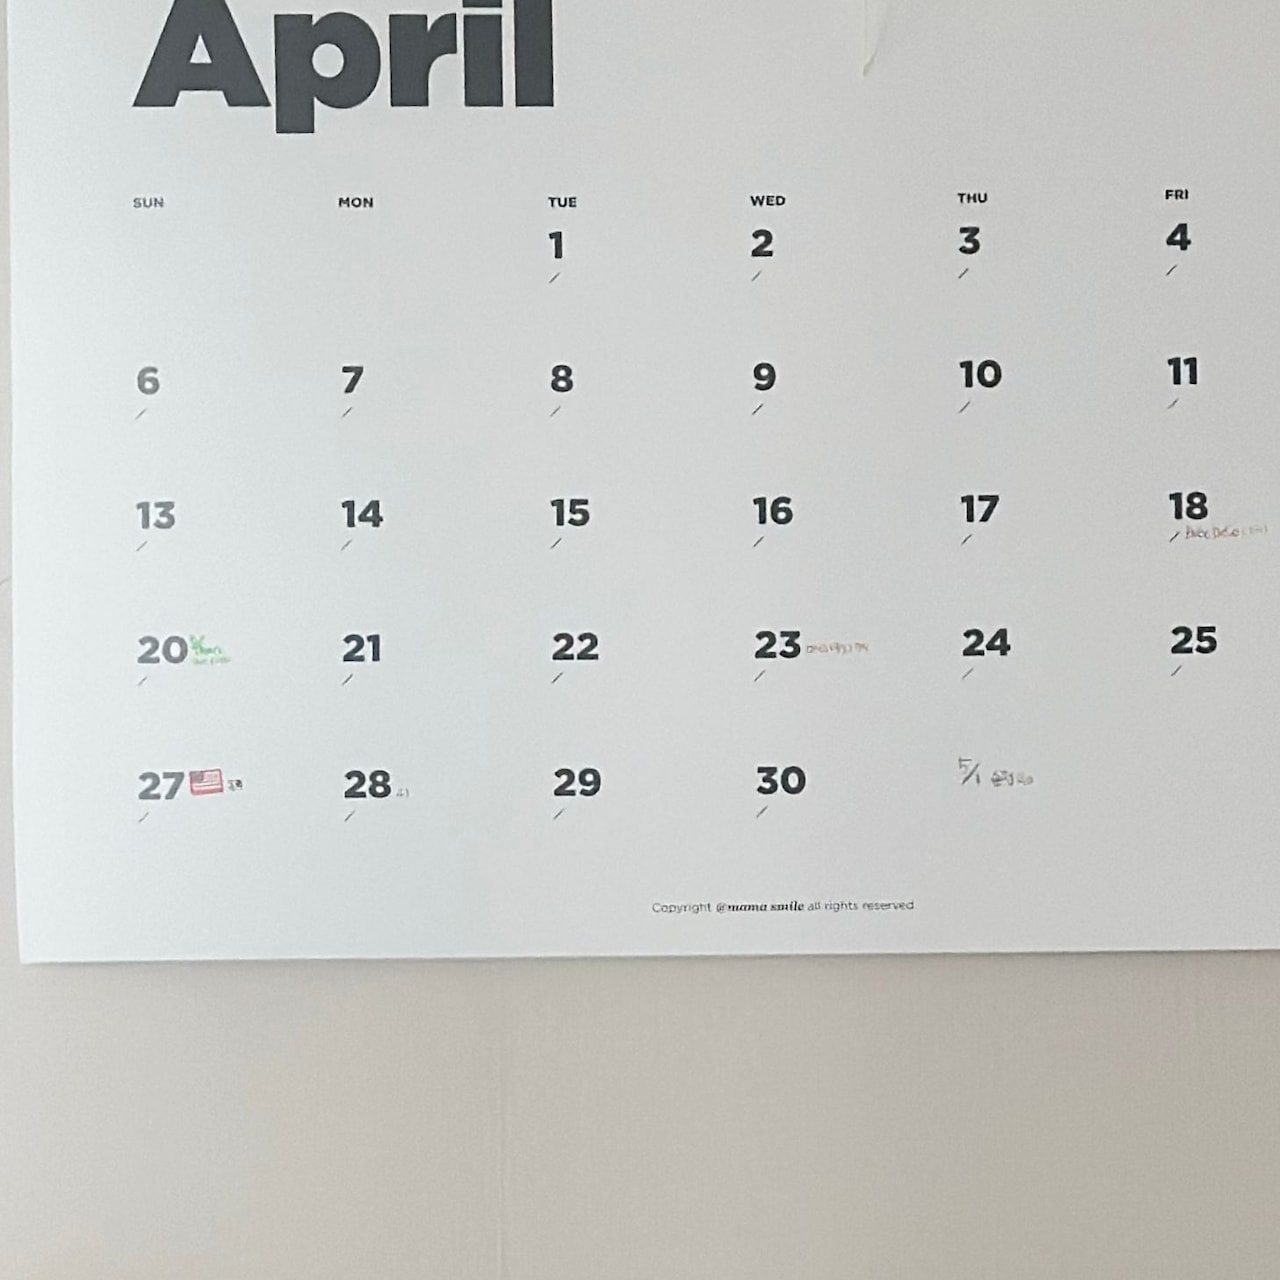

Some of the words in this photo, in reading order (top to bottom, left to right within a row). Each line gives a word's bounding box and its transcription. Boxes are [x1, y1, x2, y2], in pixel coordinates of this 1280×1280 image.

[132, 0, 555, 134] April
[133, 197, 164, 209] SUN
[338, 197, 374, 208] MON
[548, 196, 577, 208] TUE
[750, 195, 786, 207] WED
[957, 192, 988, 204] THU
[1165, 189, 1189, 200] FRI
[548, 231, 563, 259] 1
[751, 229, 774, 258] 2
[958, 226, 981, 255] 3
[1166, 222, 1192, 251] 4
[137, 366, 160, 395] 6
[341, 366, 364, 394] 7
[550, 364, 574, 393] 8
[753, 362, 776, 391] 9
[959, 359, 1002, 388] 10
[1167, 356, 1198, 386] 11
[136, 501, 176, 530] 13
[341, 500, 384, 528] 14
[550, 498, 590, 527] 15
[752, 496, 794, 525] 16
[960, 494, 1000, 523] 17
[1168, 491, 1208, 520] 18
[137, 635, 189, 664] 20
[342, 634, 381, 662] 21
[552, 632, 599, 661] 22
[754, 630, 801, 659] 23
[962, 628, 1011, 657] 24
[1170, 625, 1218, 654] 25
[138, 771, 185, 801] 27
[344, 770, 392, 799] 28
[553, 768, 601, 797] 29
[756, 765, 806, 795] 30
[651, 902, 711, 915] Copyright
[770, 900, 805, 912] smile
[807, 901, 821, 912] all
[824, 901, 858, 913] rights
[862, 900, 915, 911] reserved
